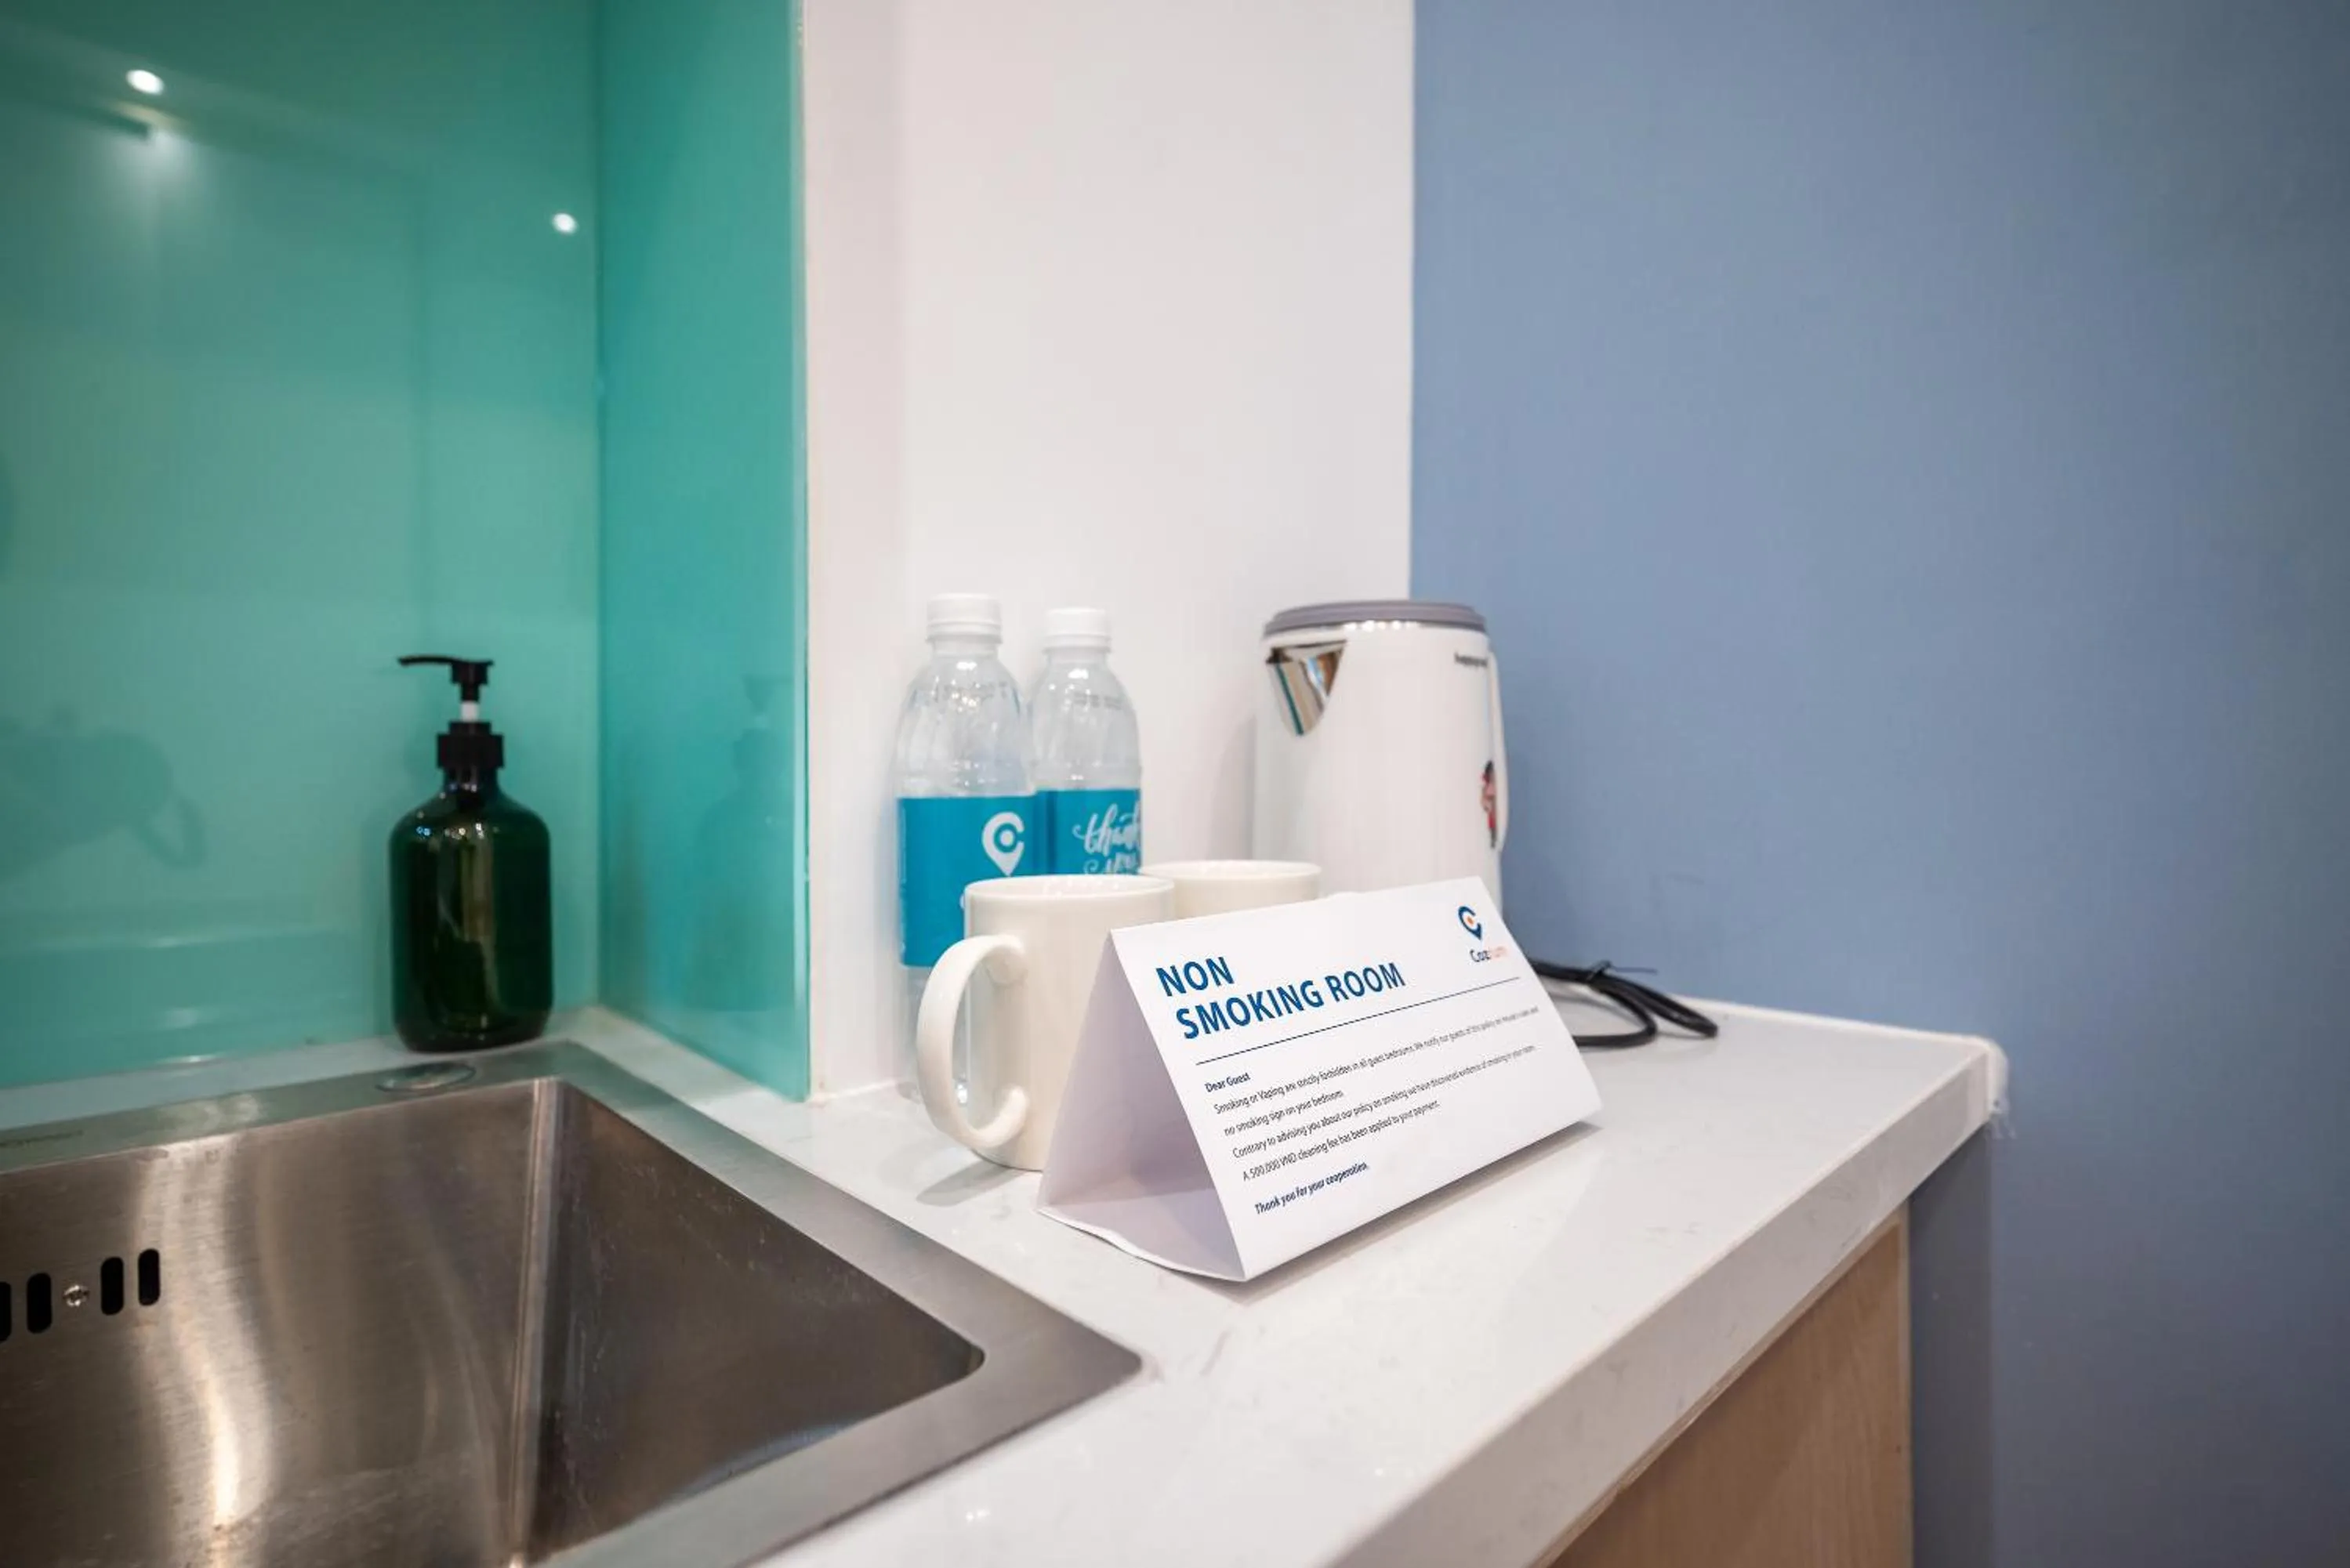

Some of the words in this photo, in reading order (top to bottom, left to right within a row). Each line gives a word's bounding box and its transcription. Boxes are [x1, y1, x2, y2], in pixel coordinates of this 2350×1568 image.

[1155, 956, 1235, 998] NON
[1176, 980, 1325, 1040] SMOKING
[1324, 962, 1406, 1002] ROOM
[1204, 1080, 1226, 1093] Dear
[1225, 1072, 1251, 1087] Guest
[1213, 1096, 1251, 1115] Smoking
[1249, 1094, 1259, 1103] or
[1257, 1086, 1286, 1101] Vaping
[1284, 1083, 1296, 1092] are
[1296, 1074, 1320, 1088] strictly
[1318, 1065, 1353, 1081] forbidden
[1367, 1054, 1386, 1068] guest
[1224, 1125, 1235, 1137] no
[1235, 1114, 1270, 1132] smoking
[1268, 1110, 1286, 1121] sign
[1285, 1106, 1296, 1116] on
[1295, 1100, 1312, 1114] your
[1231, 1140, 1267, 1159] Contrary
[1266, 1136, 1276, 1146] to
[1275, 1125, 1308, 1143] advising
[1306, 1121, 1322, 1135] you
[1320, 1113, 1343, 1128] about
[1340, 1109, 1353, 1120] our
[1353, 1103, 1373, 1117] policy
[1373, 1099, 1383, 1109] on
[1381, 1089, 1409, 1106] smoking
[1406, 1086, 1417, 1096] we
[1242, 1171, 1251, 1182] A
[1278, 1152, 1298, 1167] VND
[1296, 1143, 1329, 1161] cleaning
[1326, 1138, 1340, 1149] fee
[1337, 1133, 1353, 1145] has
[1349, 1127, 1369, 1140] been
[1368, 1116, 1393, 1134] applied
[1391, 1116, 1400, 1124] to
[1398, 1110, 1414, 1124] your
[1254, 1196, 1281, 1215] Thank
[1280, 1191, 1296, 1208] you
[1294, 1186, 1311, 1198] for
[1304, 1179, 1325, 1196] your
